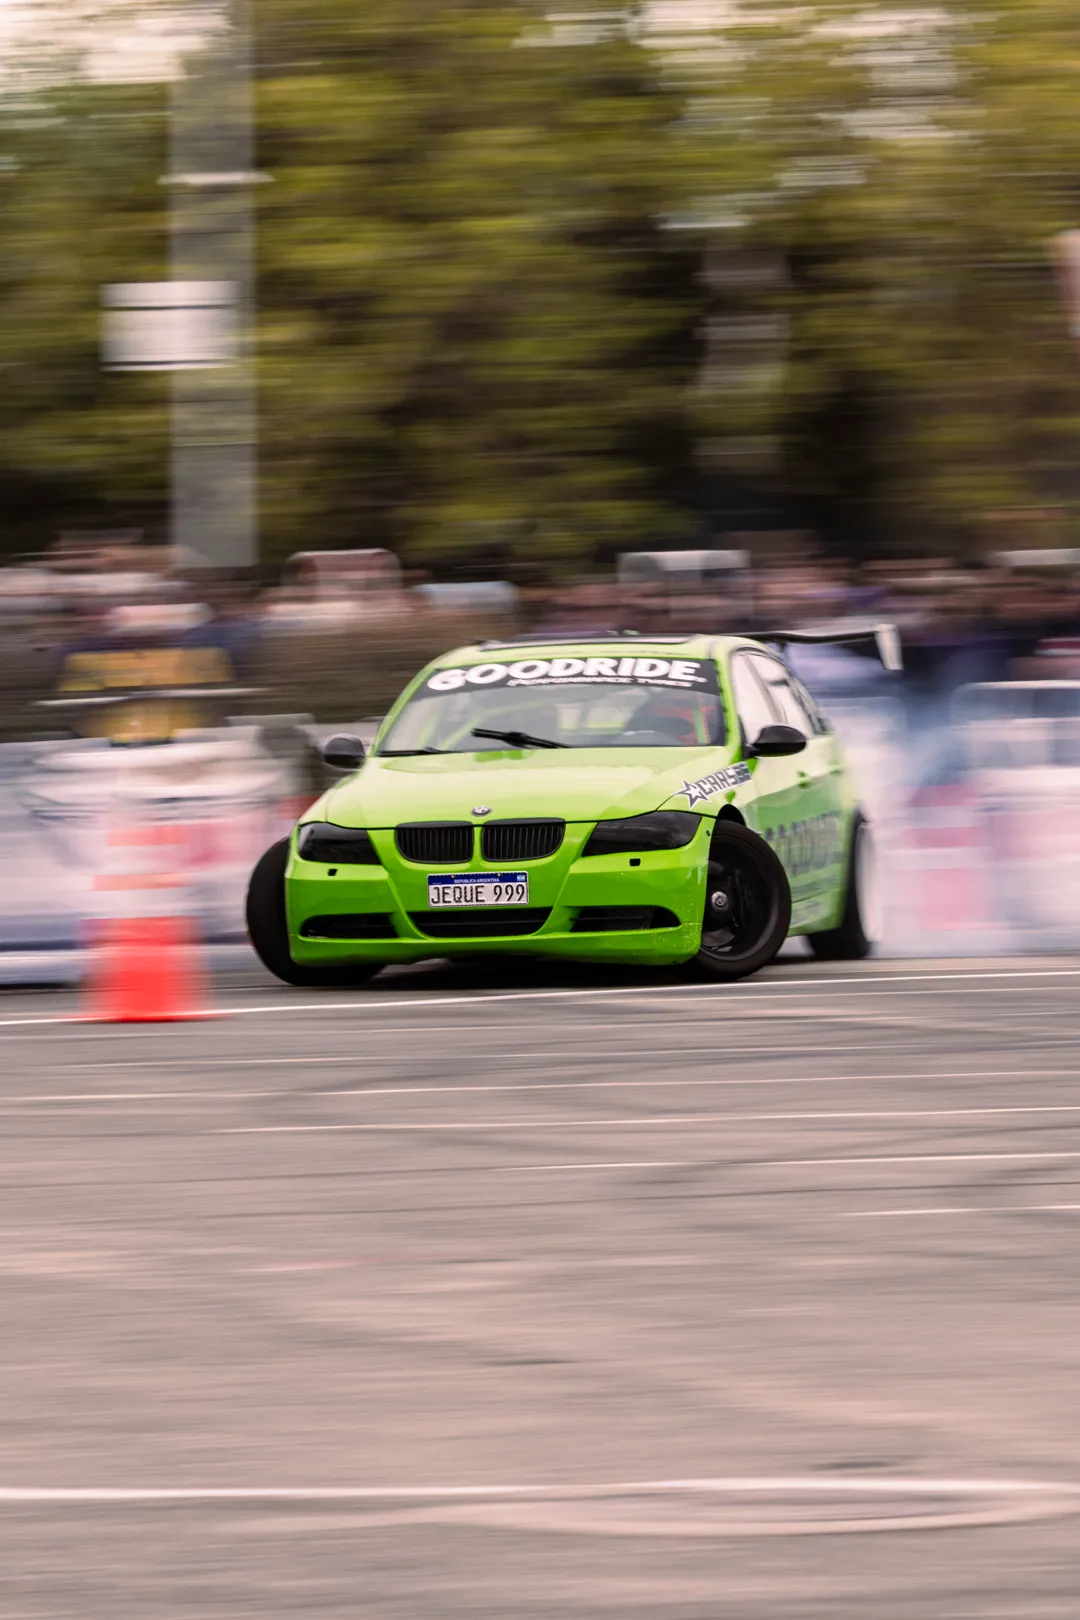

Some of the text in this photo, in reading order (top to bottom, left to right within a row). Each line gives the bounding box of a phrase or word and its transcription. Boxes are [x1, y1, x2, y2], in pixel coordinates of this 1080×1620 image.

[427, 658, 701, 690] GOODRIDE
[431, 884, 525, 904] JEQUE 999
